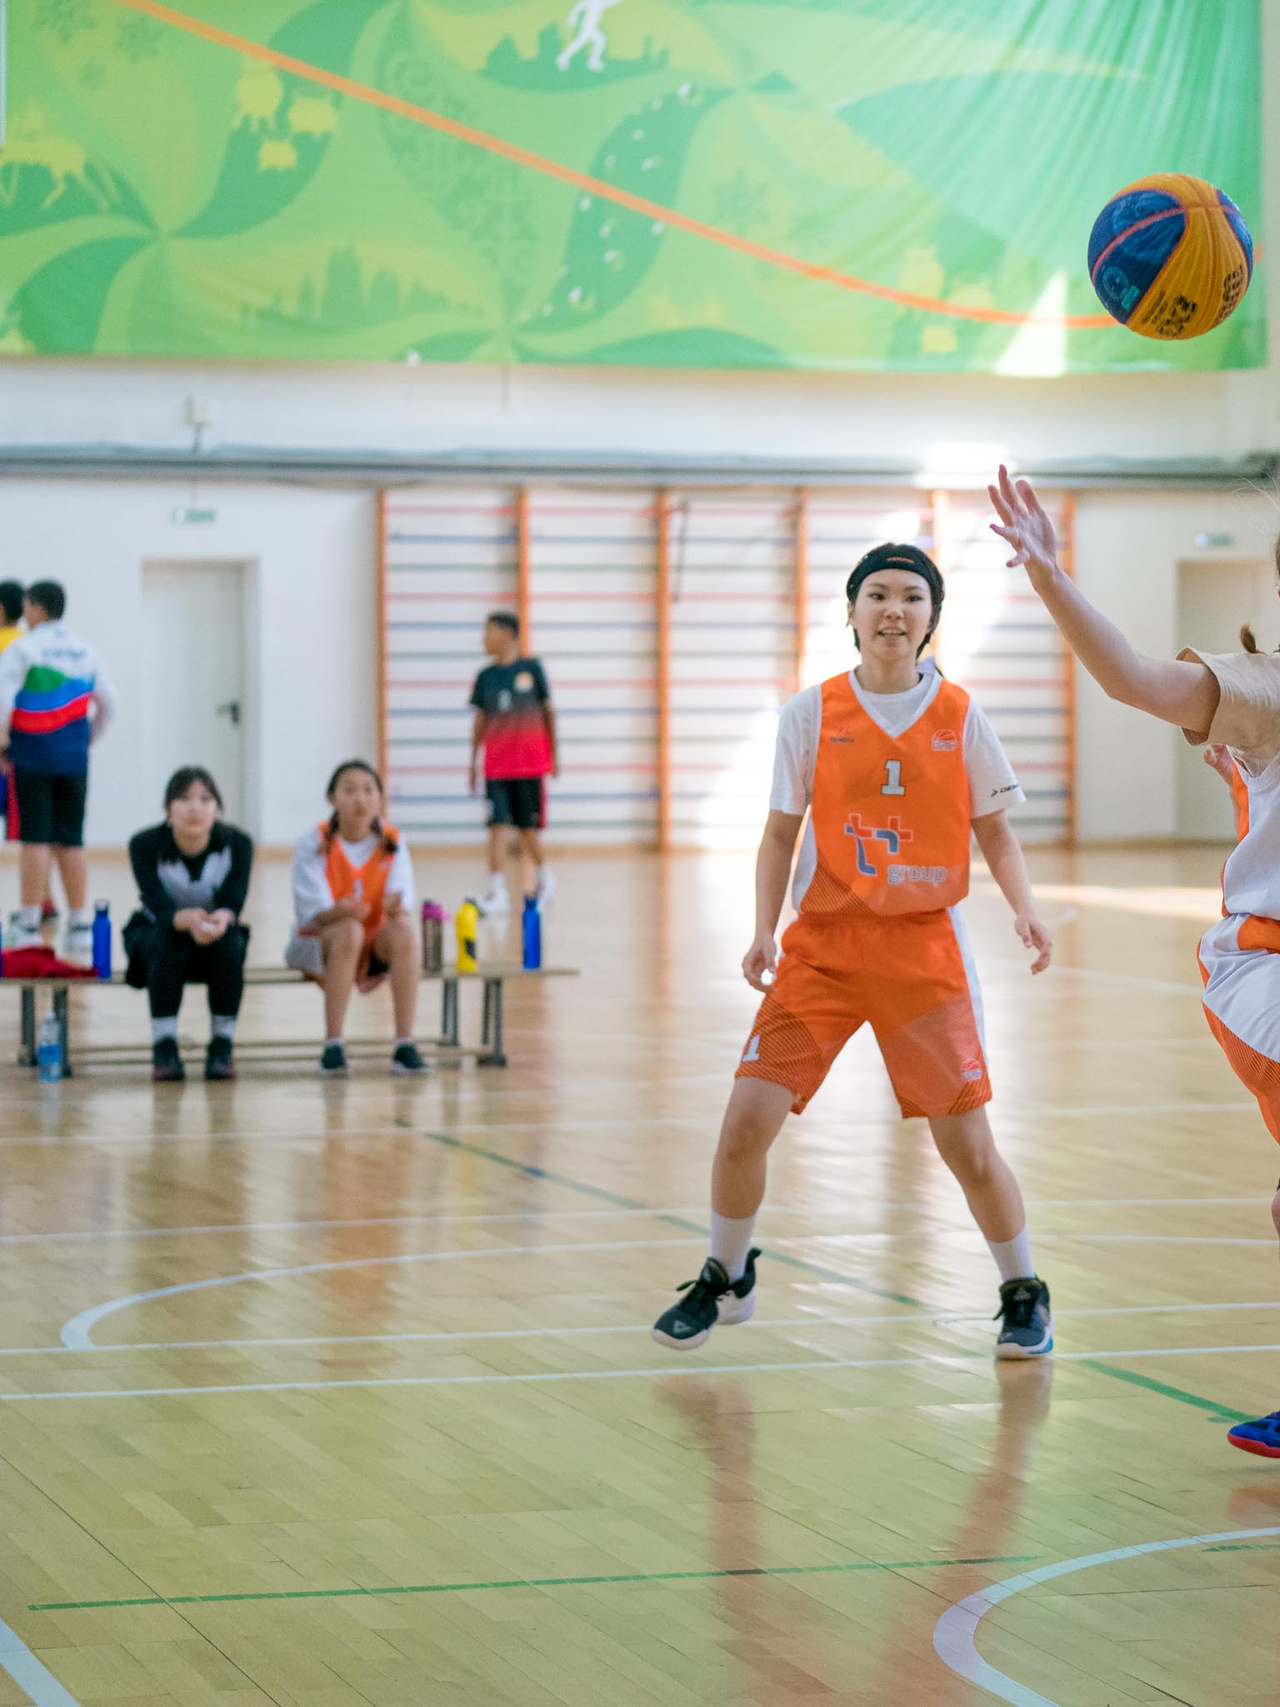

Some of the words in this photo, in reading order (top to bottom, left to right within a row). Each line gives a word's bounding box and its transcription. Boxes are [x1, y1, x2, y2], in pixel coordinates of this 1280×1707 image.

[880, 759, 906, 796] 1
[887, 863, 947, 886] group
[742, 1034, 760, 1062] 1
